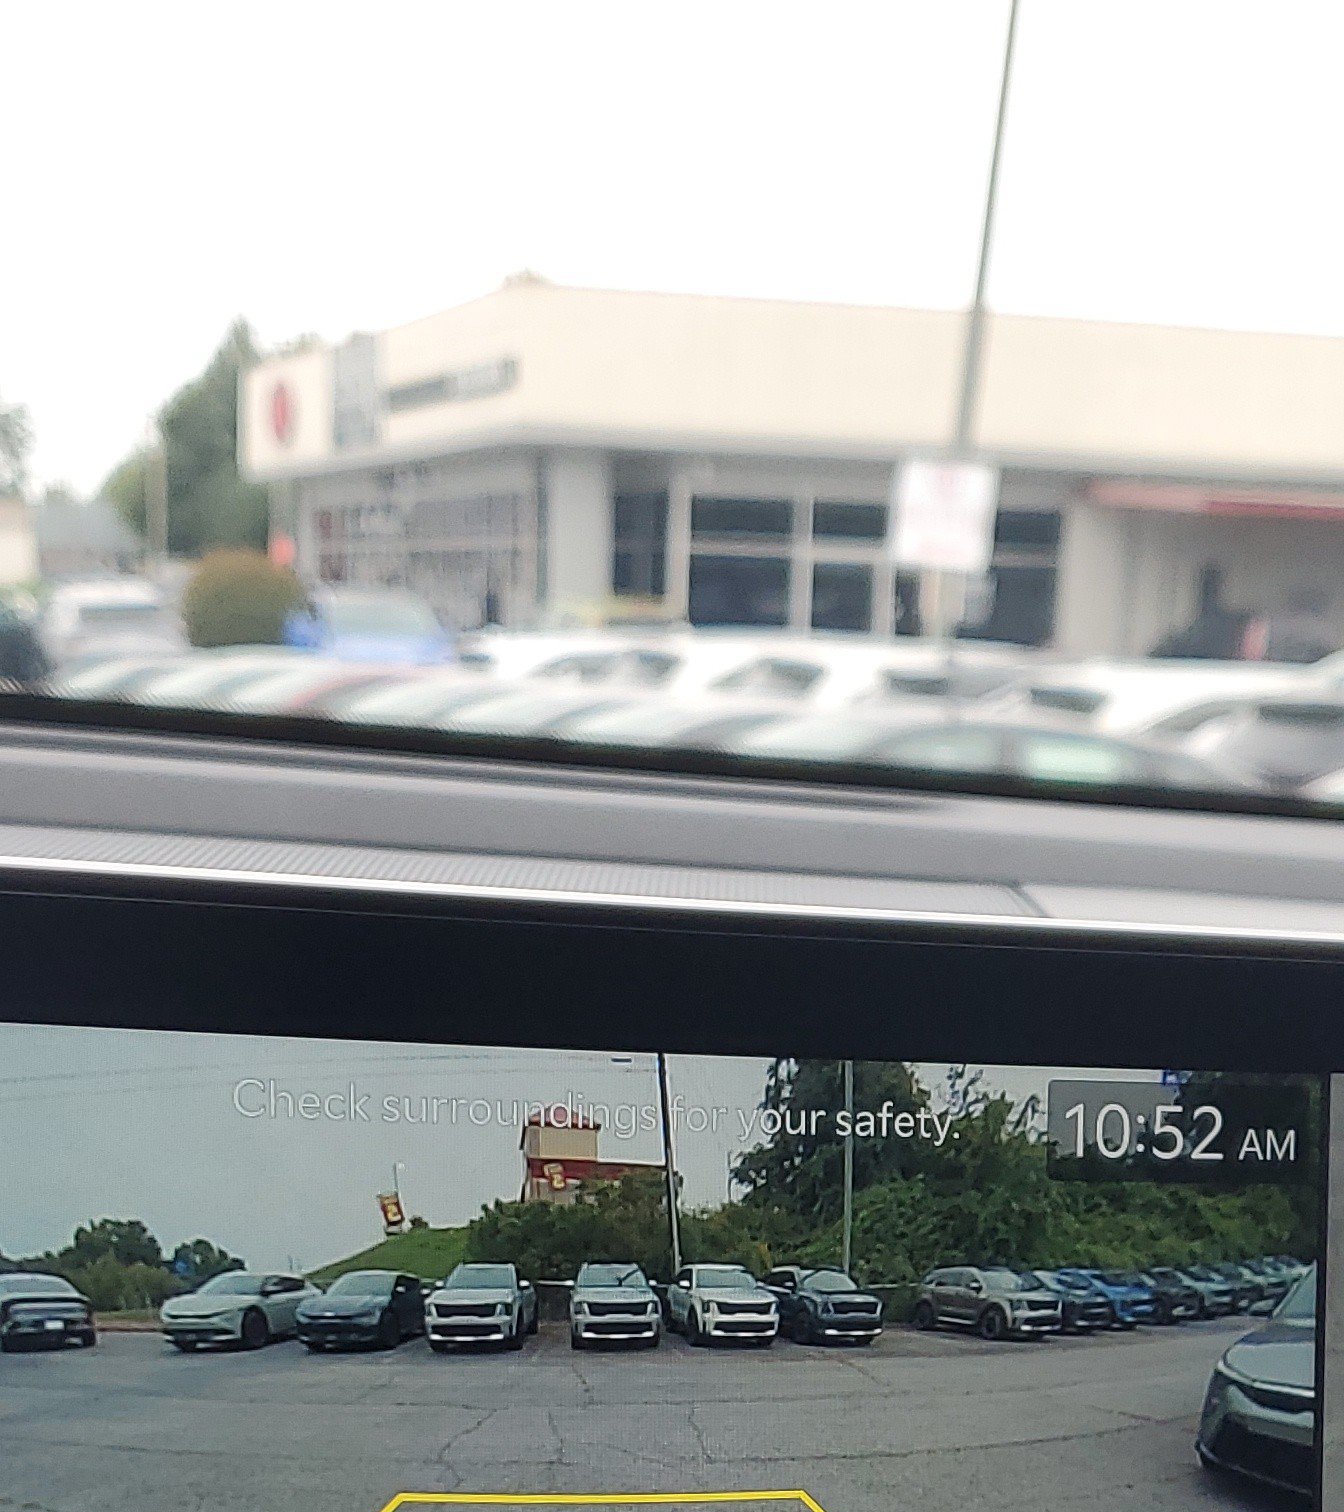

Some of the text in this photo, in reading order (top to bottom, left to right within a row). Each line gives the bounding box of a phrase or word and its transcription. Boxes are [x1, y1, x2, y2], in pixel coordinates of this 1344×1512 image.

[233, 1078, 960, 1147] Check surroundings for your safety.
[1065, 1103, 1295, 1161] 10:52 AM
